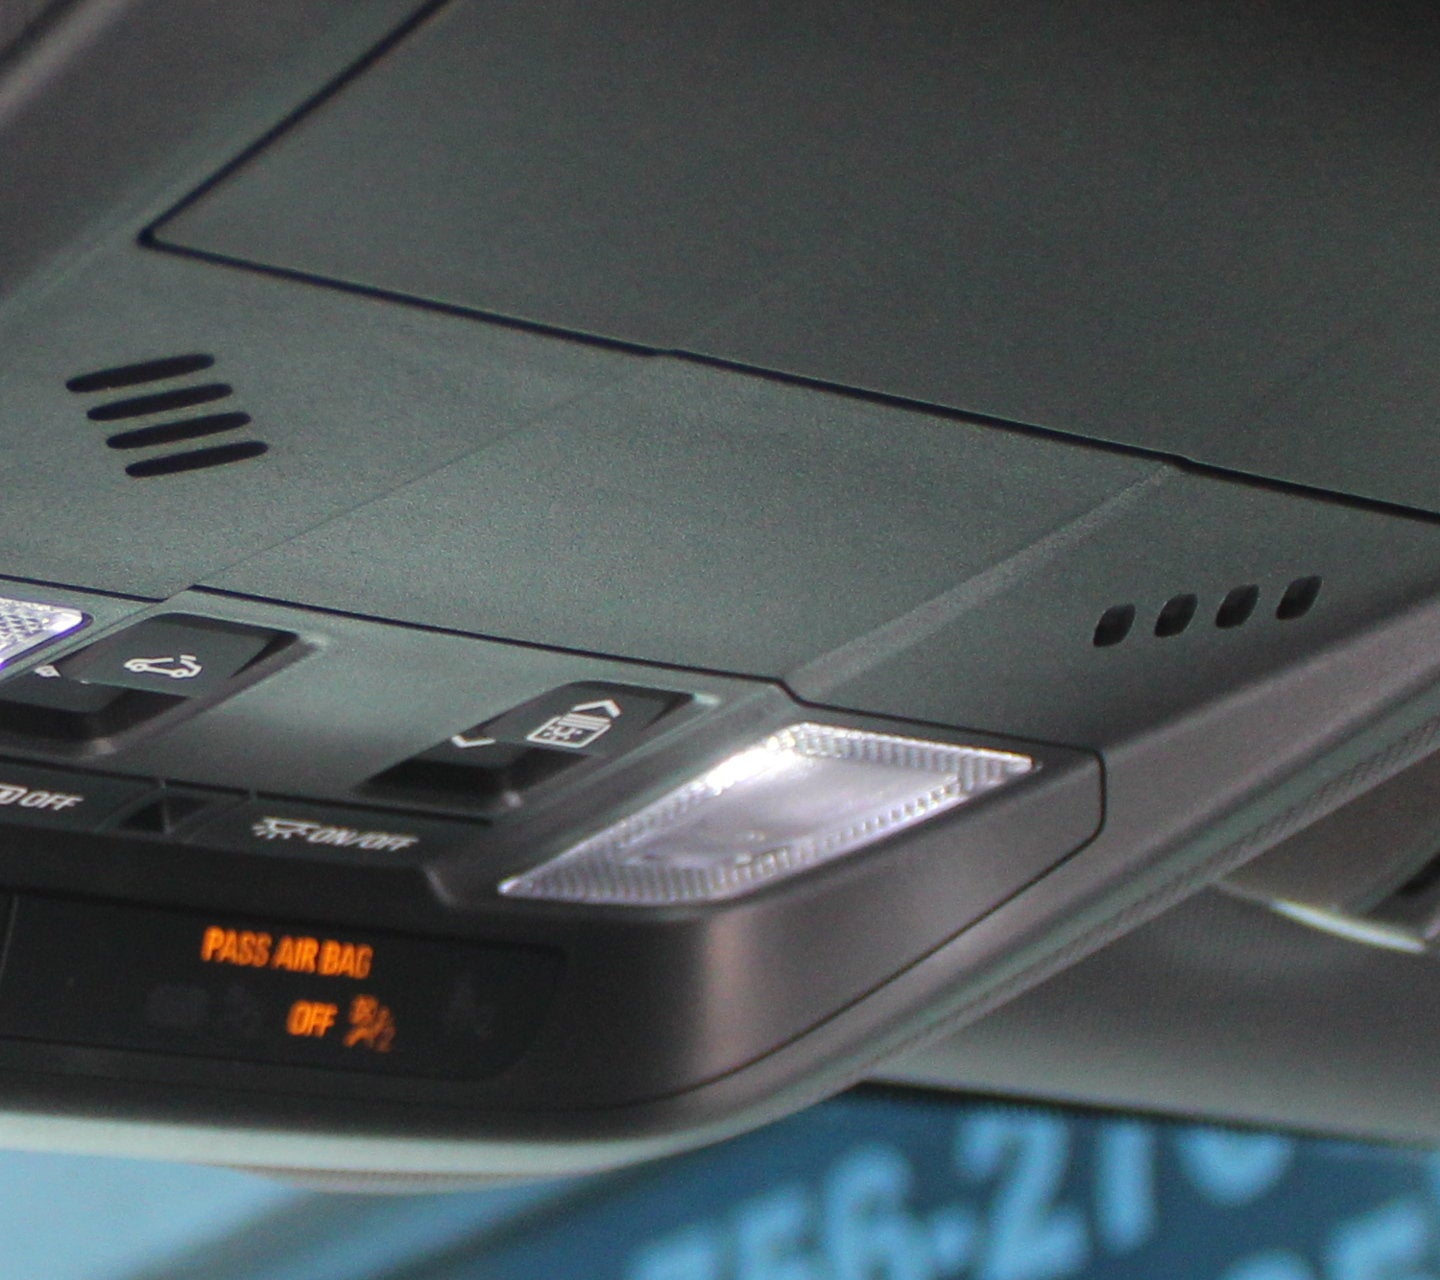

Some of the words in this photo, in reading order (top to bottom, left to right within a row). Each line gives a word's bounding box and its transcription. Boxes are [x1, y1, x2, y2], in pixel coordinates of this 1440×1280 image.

[19, 789, 84, 812] OFF
[305, 825, 419, 853] ON/OFF
[201, 925, 273, 969] PASS
[270, 934, 320, 976] AIR
[319, 939, 375, 981] BAG
[287, 999, 339, 1039] OFF
